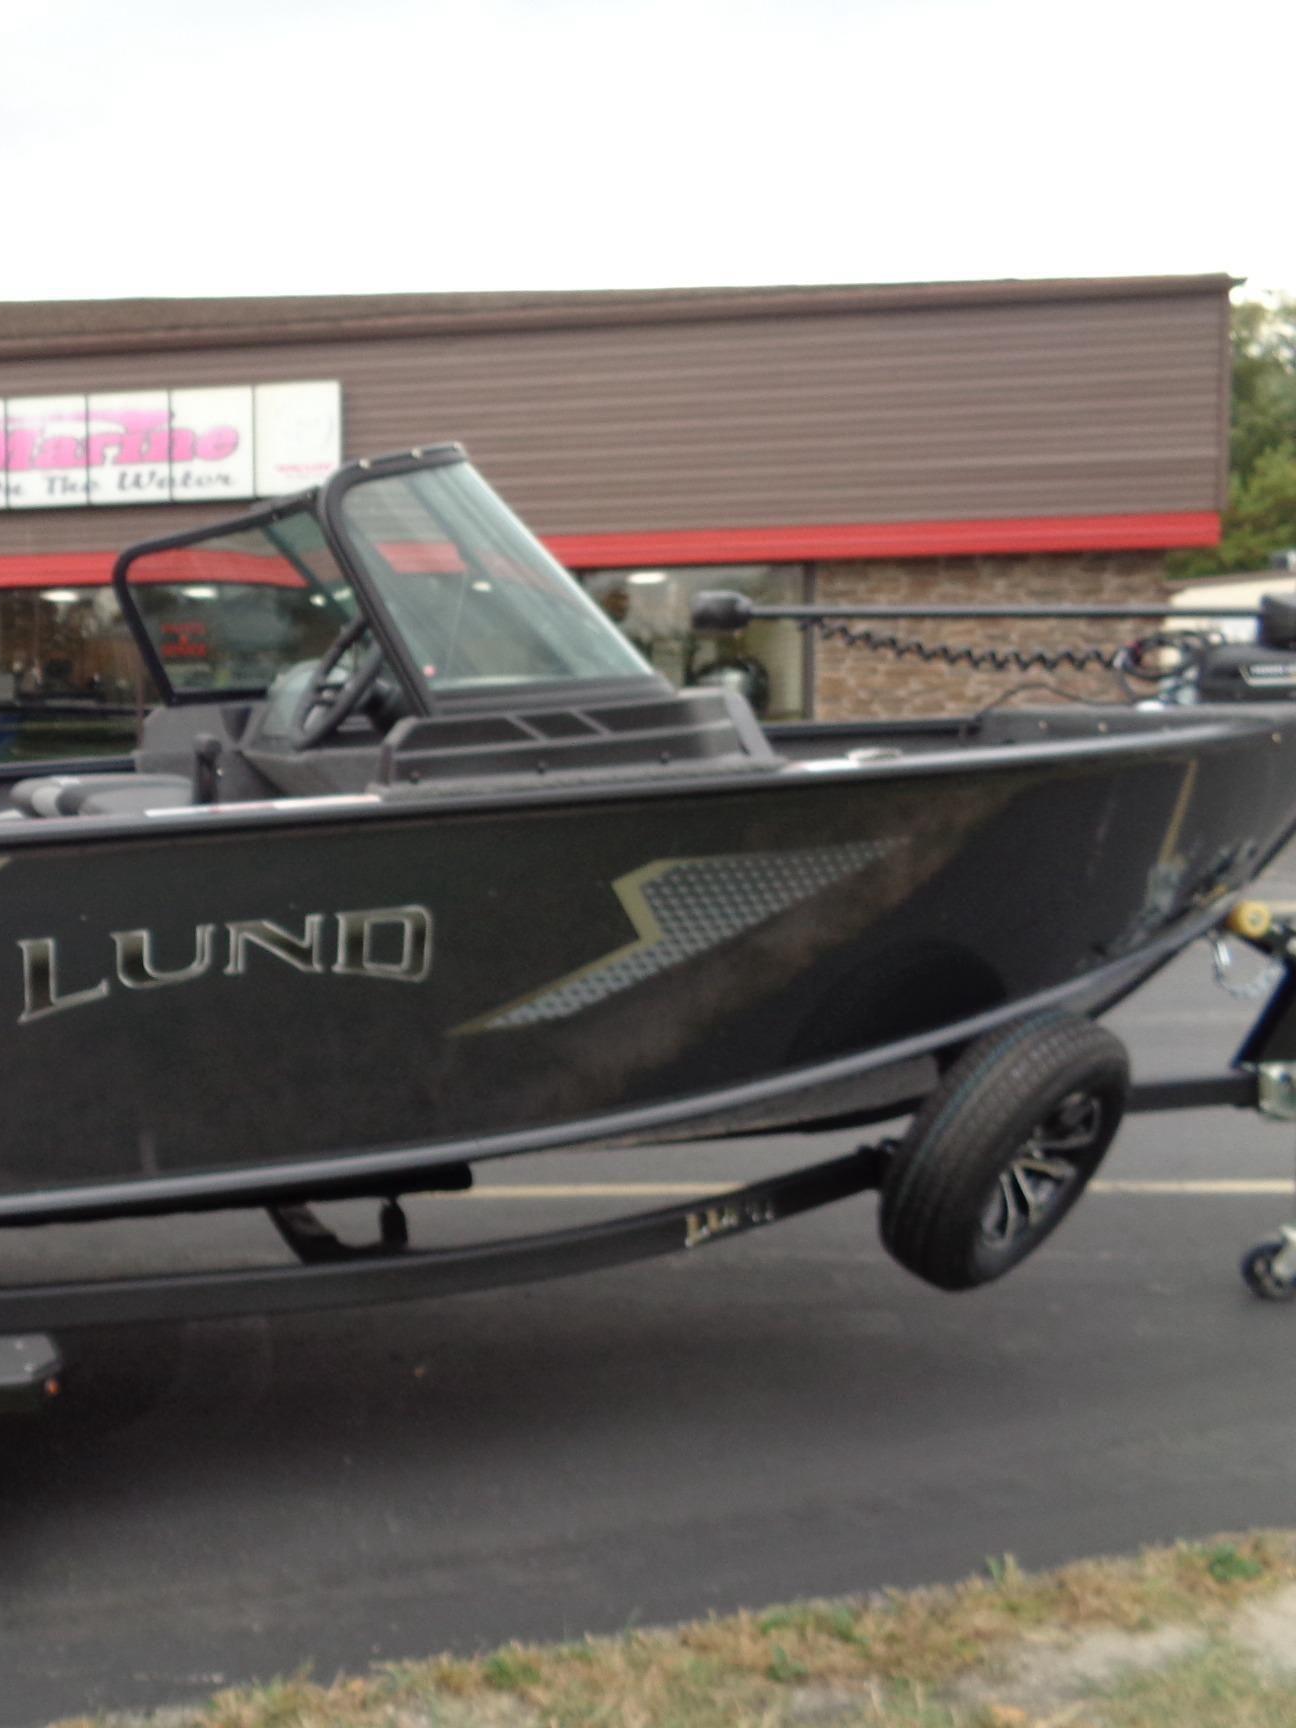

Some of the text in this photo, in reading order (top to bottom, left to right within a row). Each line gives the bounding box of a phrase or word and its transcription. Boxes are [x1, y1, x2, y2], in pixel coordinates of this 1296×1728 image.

[45, 473, 100, 497] The
[117, 468, 234, 492] Water
[17, 904, 433, 1024] LUND
